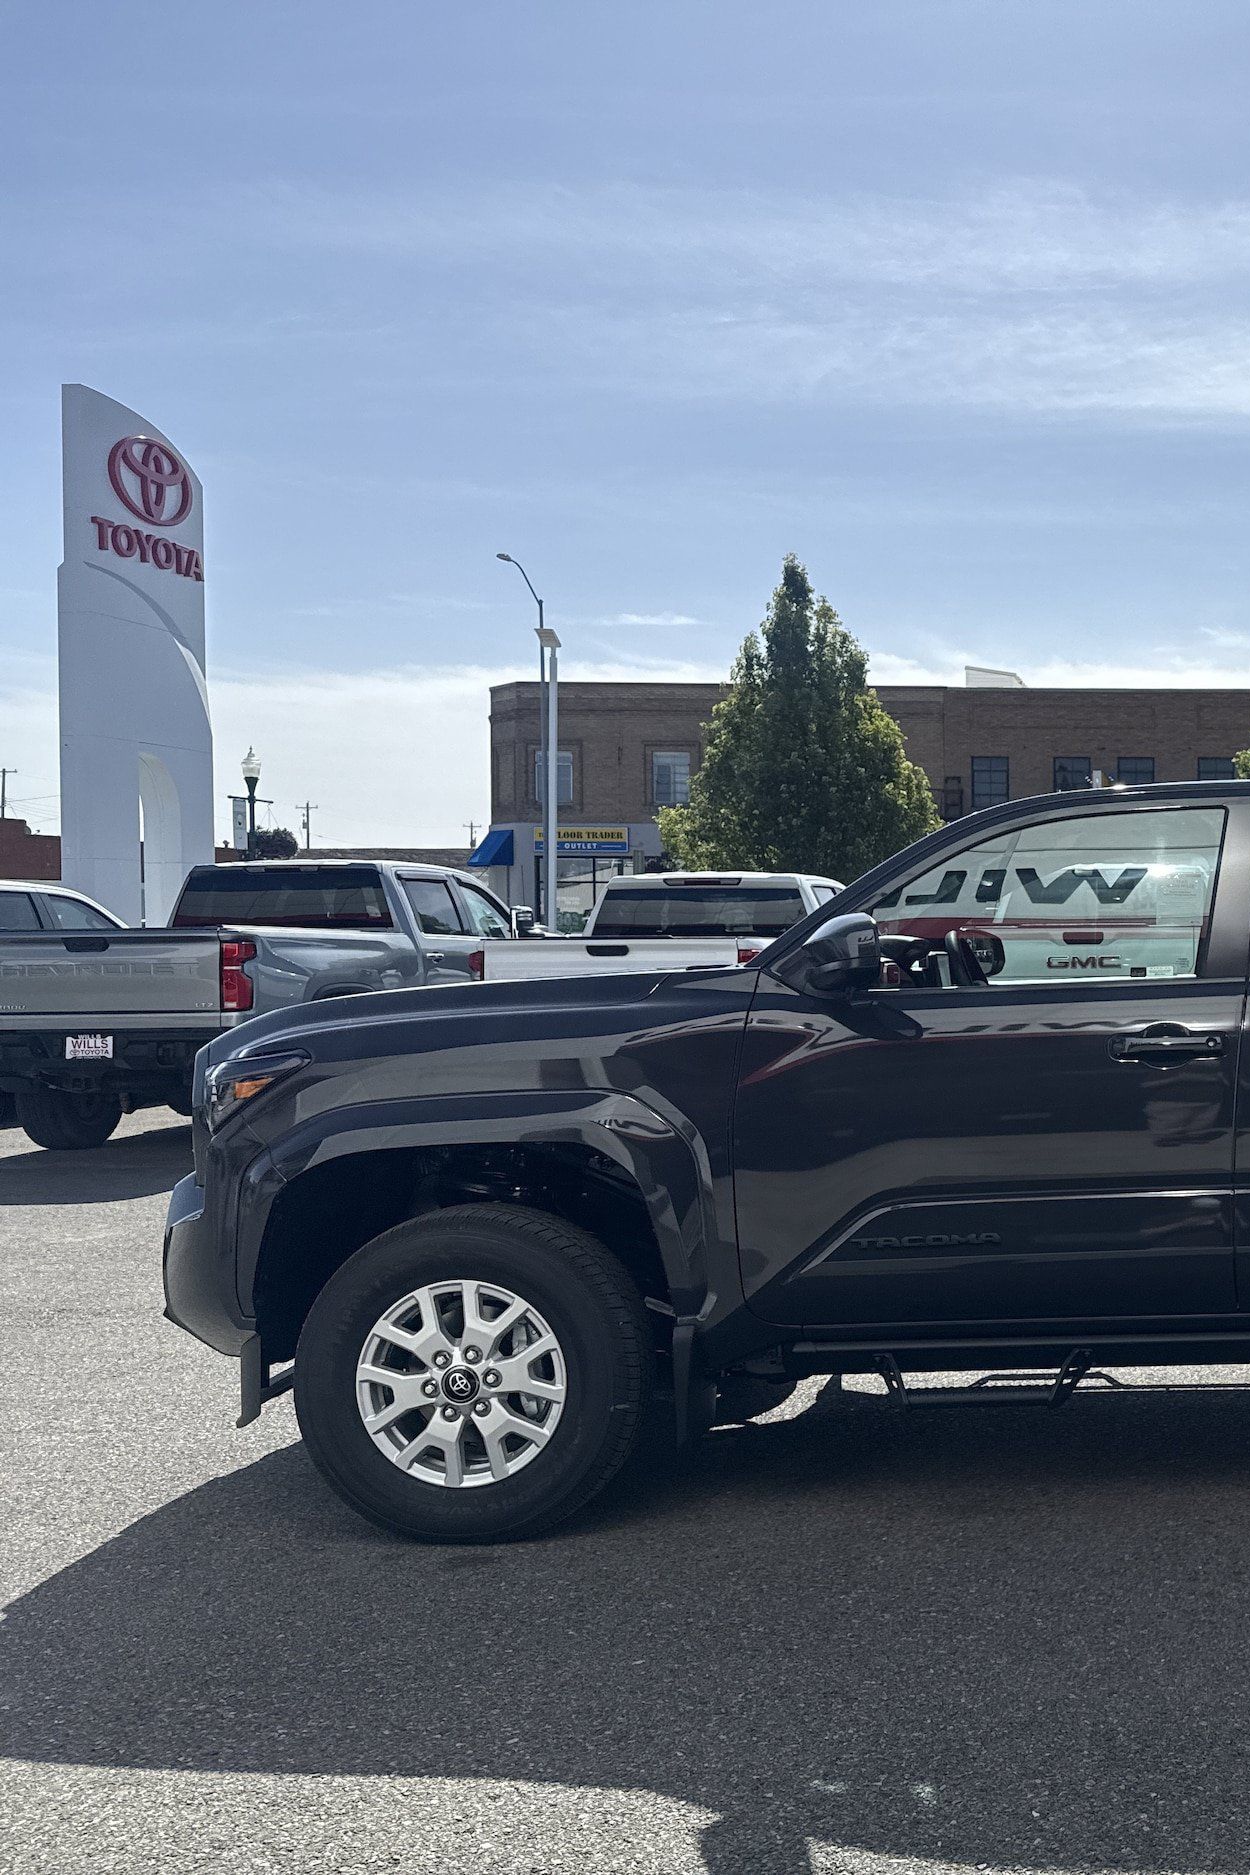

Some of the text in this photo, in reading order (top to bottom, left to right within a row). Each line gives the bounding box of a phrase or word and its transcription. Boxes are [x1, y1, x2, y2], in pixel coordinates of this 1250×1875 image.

[90, 515, 204, 582] TOYOTA
[1047, 956, 1121, 969] GMC
[72, 1040, 108, 1048] WILLS
[850, 1232, 1001, 1249] TACOMA
